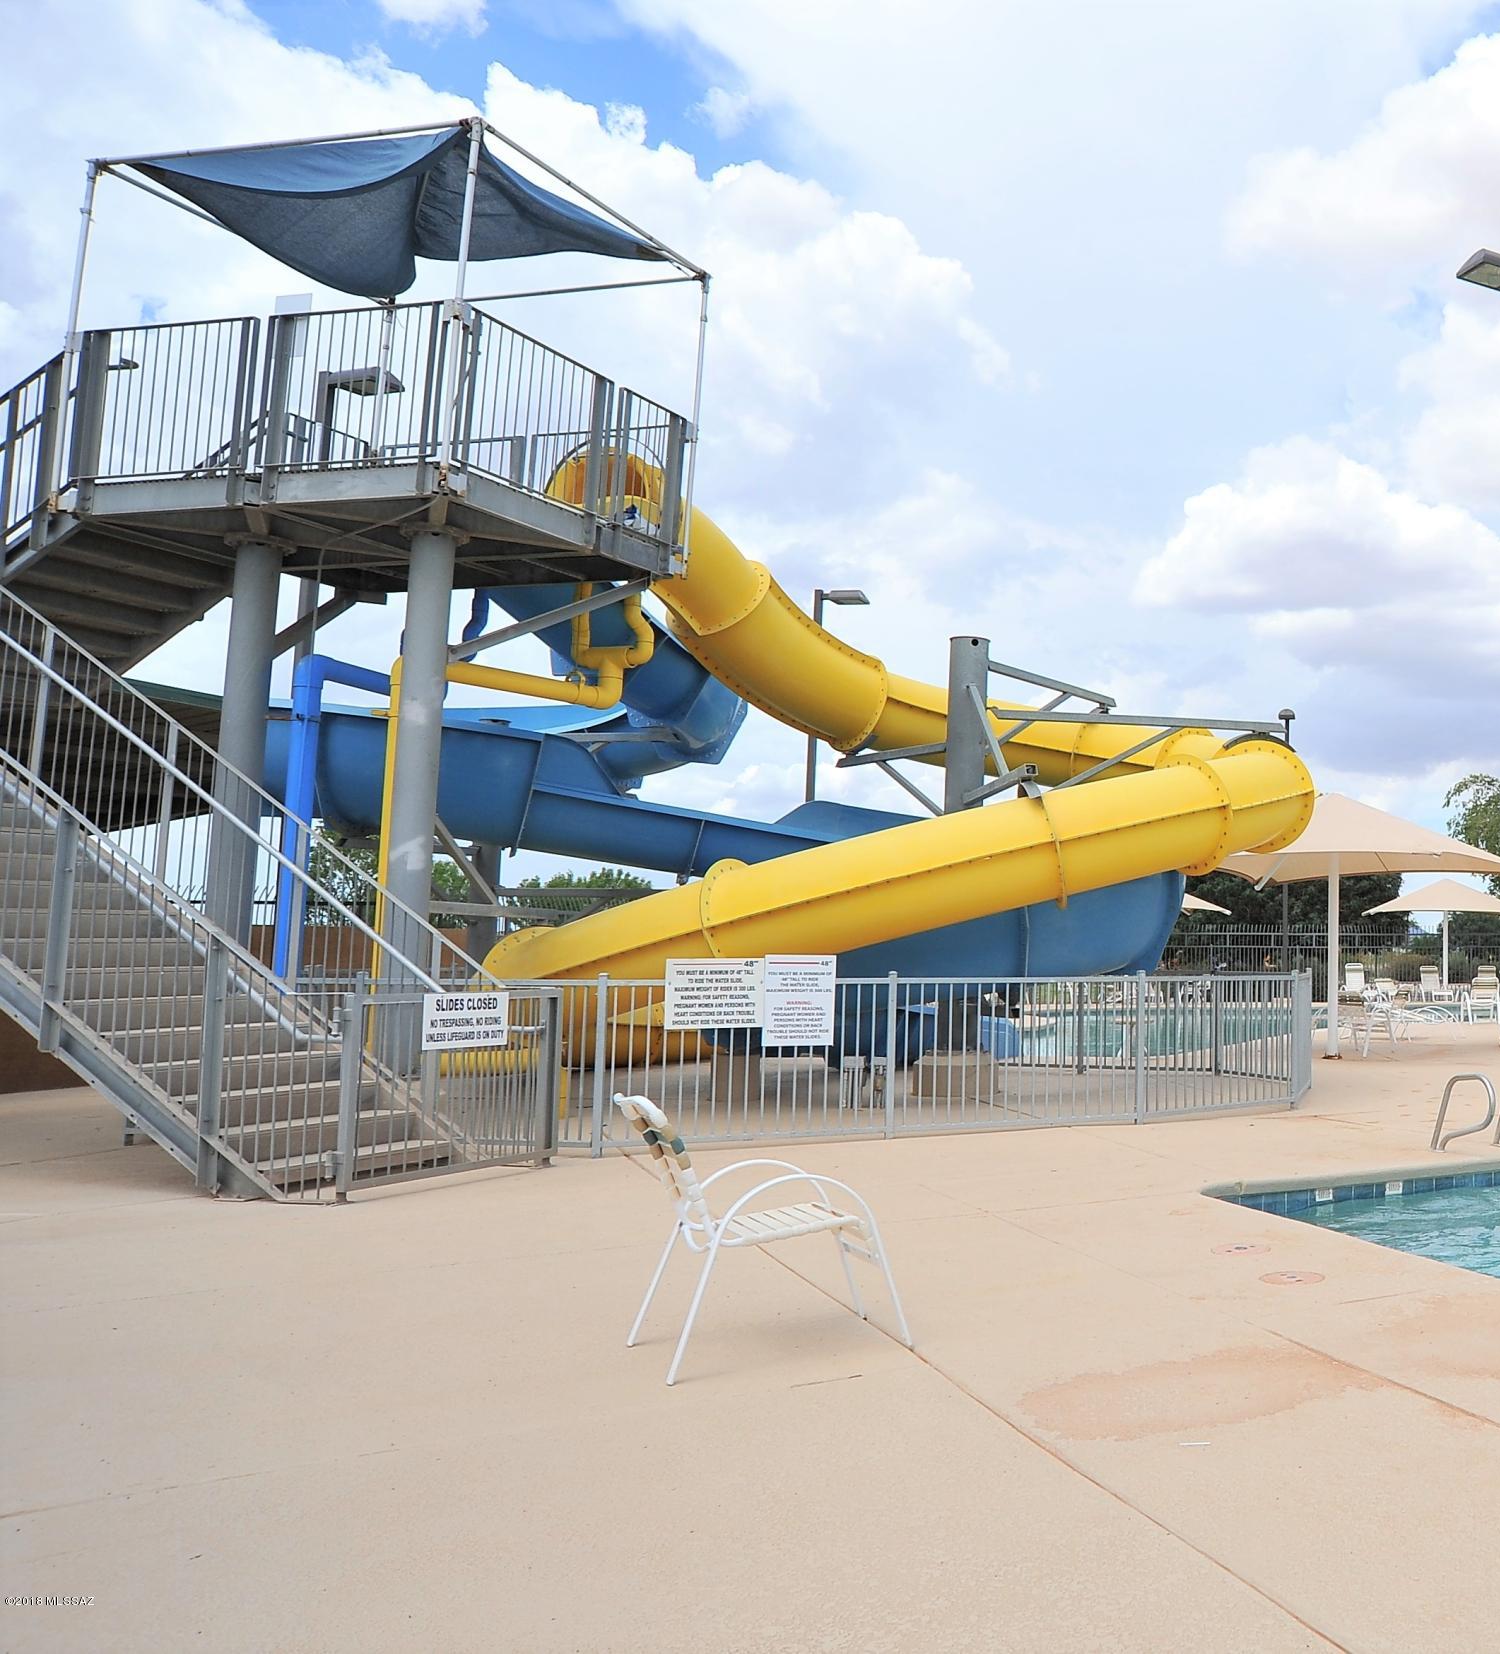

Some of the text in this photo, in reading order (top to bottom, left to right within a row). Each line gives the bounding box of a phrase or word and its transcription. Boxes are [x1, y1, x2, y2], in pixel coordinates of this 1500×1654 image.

[435, 997, 498, 1012] SLIDES CLOSED
[430, 1019, 438, 1028] NO
[475, 1017, 483, 1026] NO
[484, 1016, 501, 1026] RIDING
[426, 1029, 504, 1043] UNLESS LIFEGUARD IS ON DUTY
